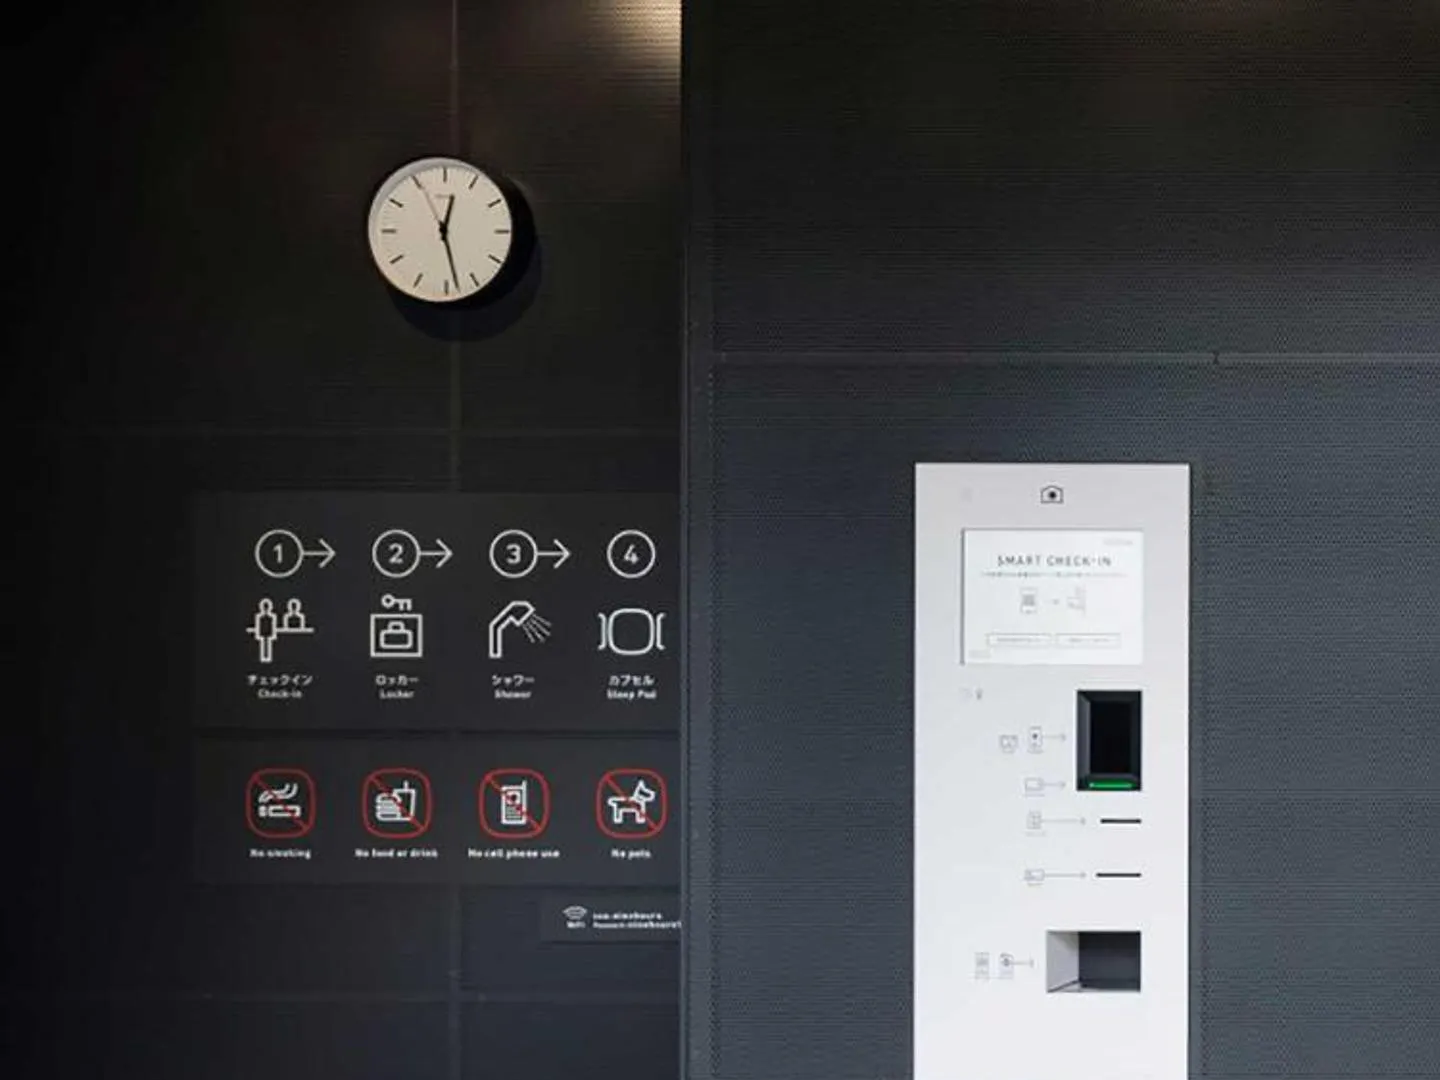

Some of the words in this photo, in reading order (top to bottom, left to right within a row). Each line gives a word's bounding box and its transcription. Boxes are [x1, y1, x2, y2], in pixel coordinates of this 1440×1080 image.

[272, 544, 283, 563] 1
[388, 543, 404, 564] 2
[506, 543, 521, 564] 3
[623, 543, 639, 564] 4
[998, 555, 1041, 567] SMART
[1046, 555, 1112, 567] CHECK-IN
[247, 674, 313, 686] チェックイン
[375, 674, 420, 686] ロッカー
[492, 674, 535, 687] シャワー
[608, 675, 655, 687] カプセル
[250, 848, 265, 858] No
[267, 848, 311, 860] smoking
[354, 848, 369, 858] No
[371, 848, 394, 858] food
[396, 849, 407, 858] or
[409, 848, 438, 858] drink
[468, 848, 482, 858] No
[484, 848, 504, 858] cell
[506, 848, 538, 860] phone
[540, 849, 560, 858] use
[610, 848, 626, 858] No
[628, 848, 652, 860] pets
